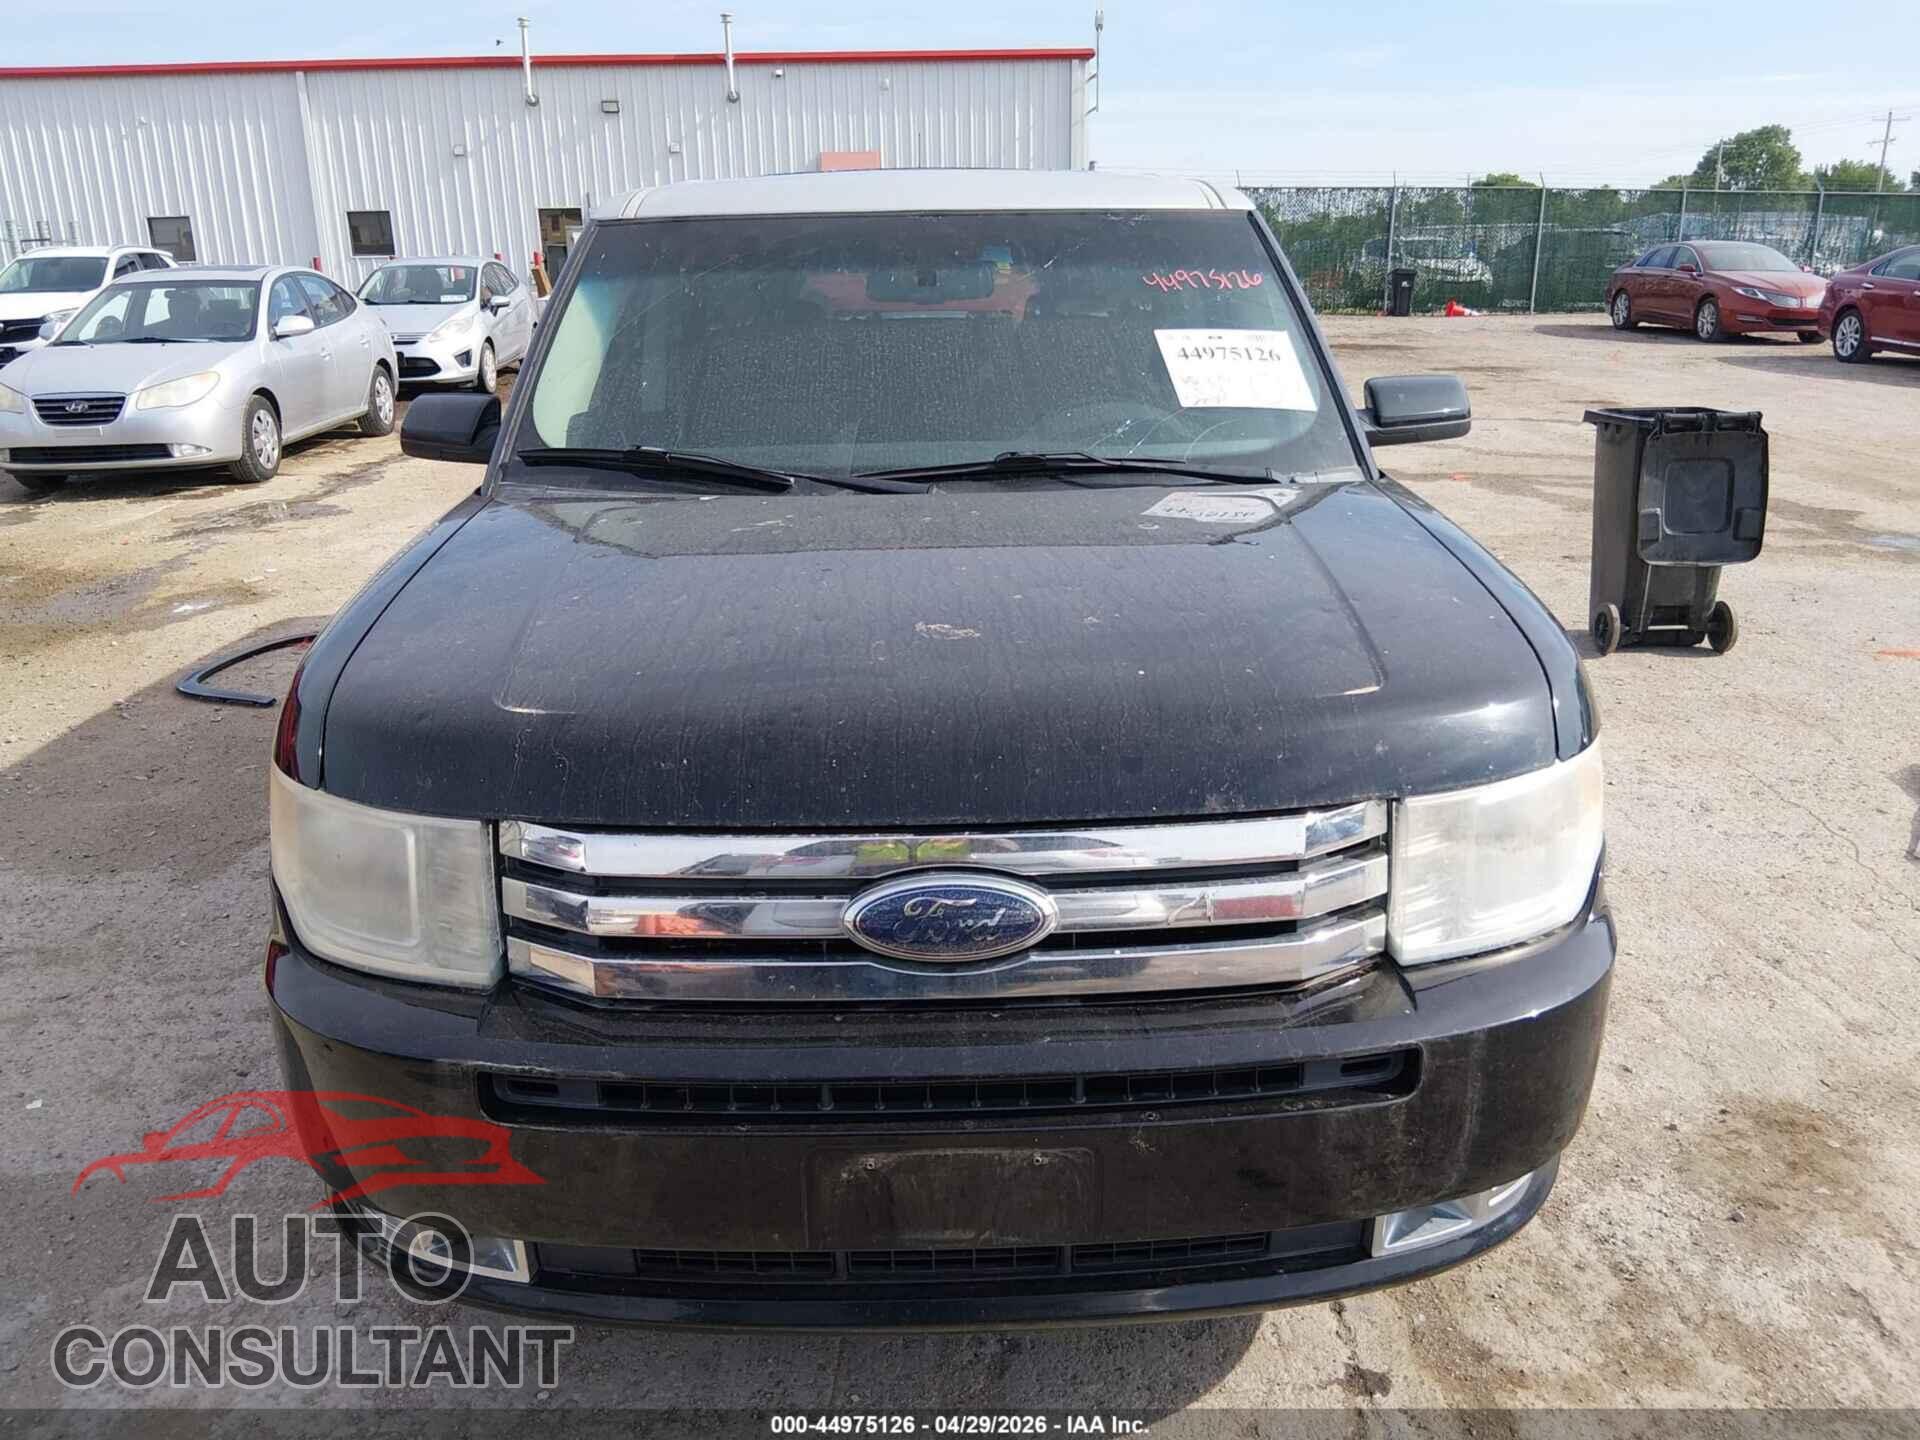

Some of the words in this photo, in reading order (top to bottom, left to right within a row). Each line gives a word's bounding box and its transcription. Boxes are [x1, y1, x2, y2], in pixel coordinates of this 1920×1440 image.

[1143, 268, 1263, 292] 44975126
[1176, 346, 1281, 361] 44975126
[892, 896, 1006, 942] Ford
